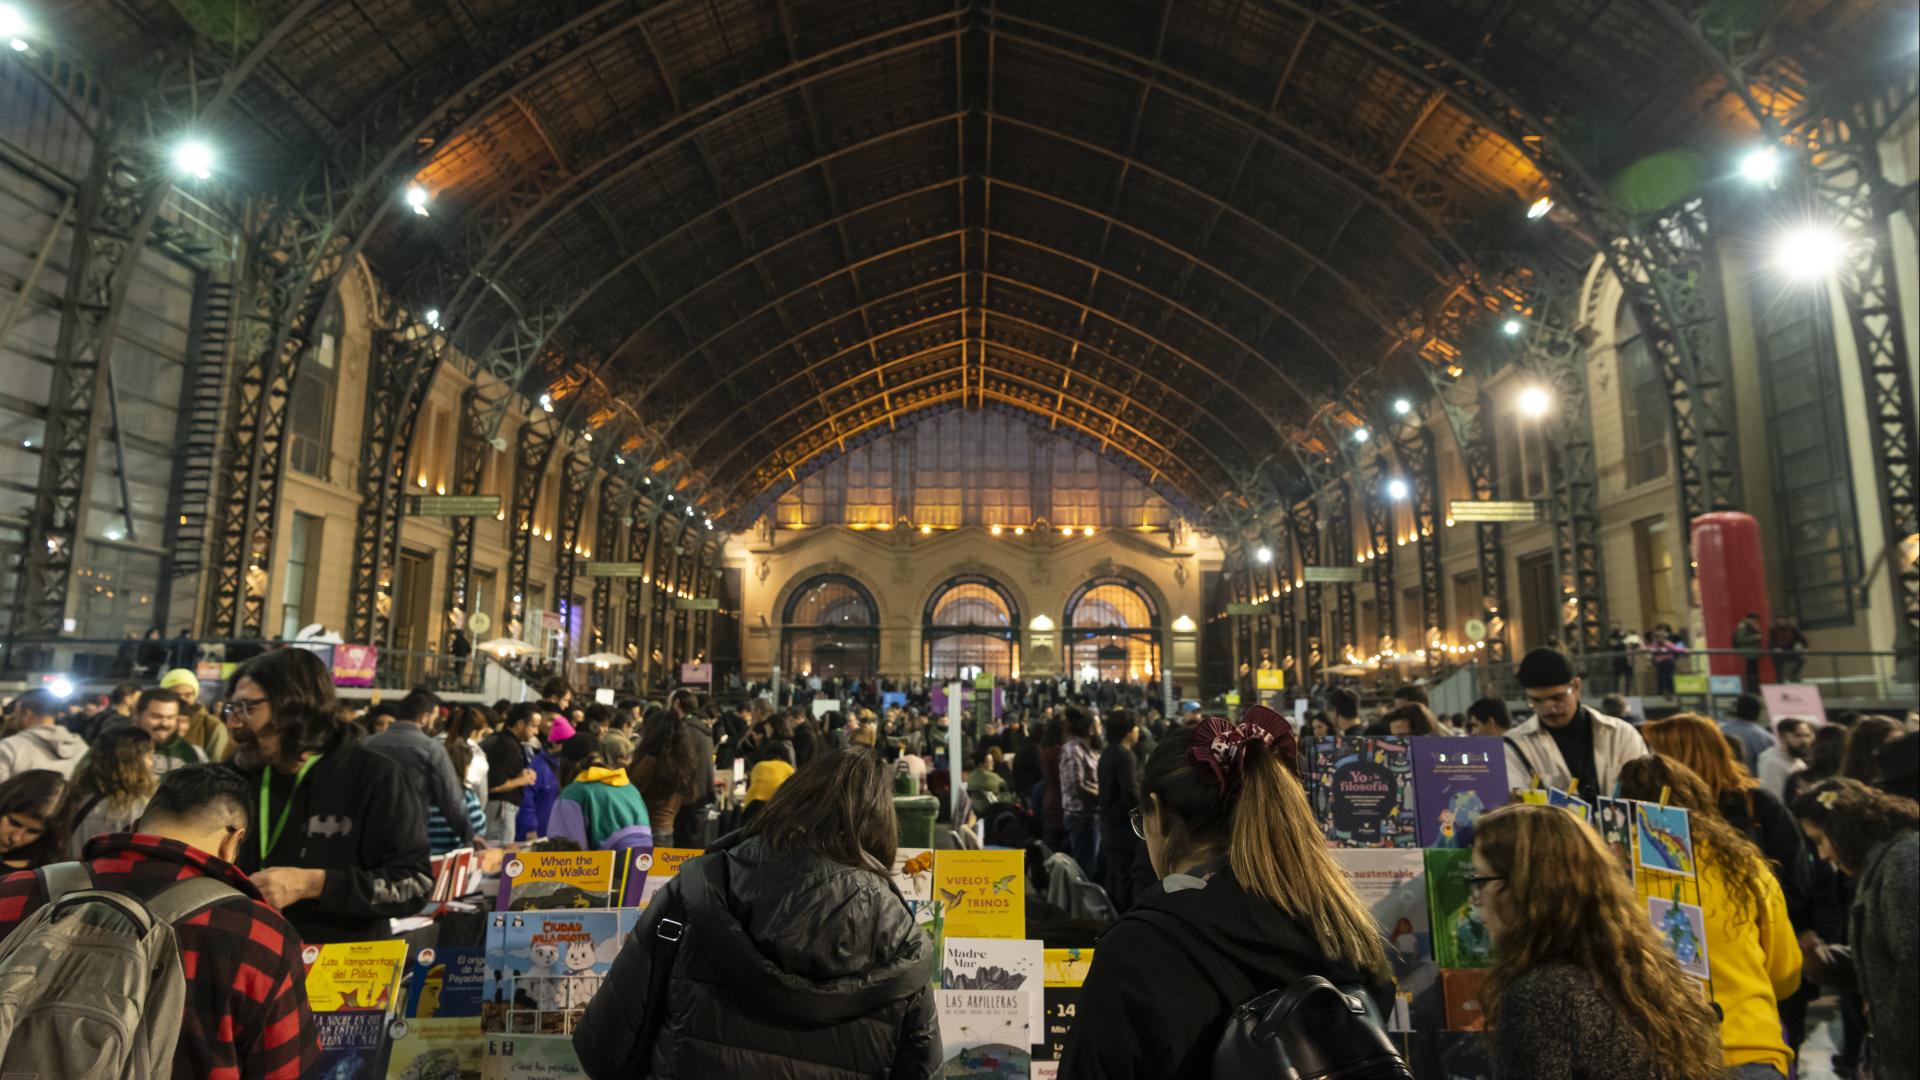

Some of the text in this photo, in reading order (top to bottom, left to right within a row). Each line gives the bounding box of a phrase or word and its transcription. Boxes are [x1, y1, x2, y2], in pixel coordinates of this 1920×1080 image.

[1350, 771, 1367, 783] Yo
[540, 854, 593, 867] When the
[560, 865, 600, 877] Walked
[1354, 868, 1414, 879] sustentable
[946, 876, 990, 886] VUELOS
[979, 887, 986, 897] Y
[967, 898, 1010, 908] TRINOS
[543, 921, 583, 933] CIUDAD
[948, 948, 987, 959] Madre
[320, 956, 394, 971] Las lamparitas
[457, 955, 485, 967] El orig
[954, 958, 977, 968] Mar
[332, 967, 378, 979] del Pillán
[461, 965, 470, 974] de
[945, 993, 1019, 1009] LAS ARPILLERAS
[1056, 1003, 1076, 1018] 14
